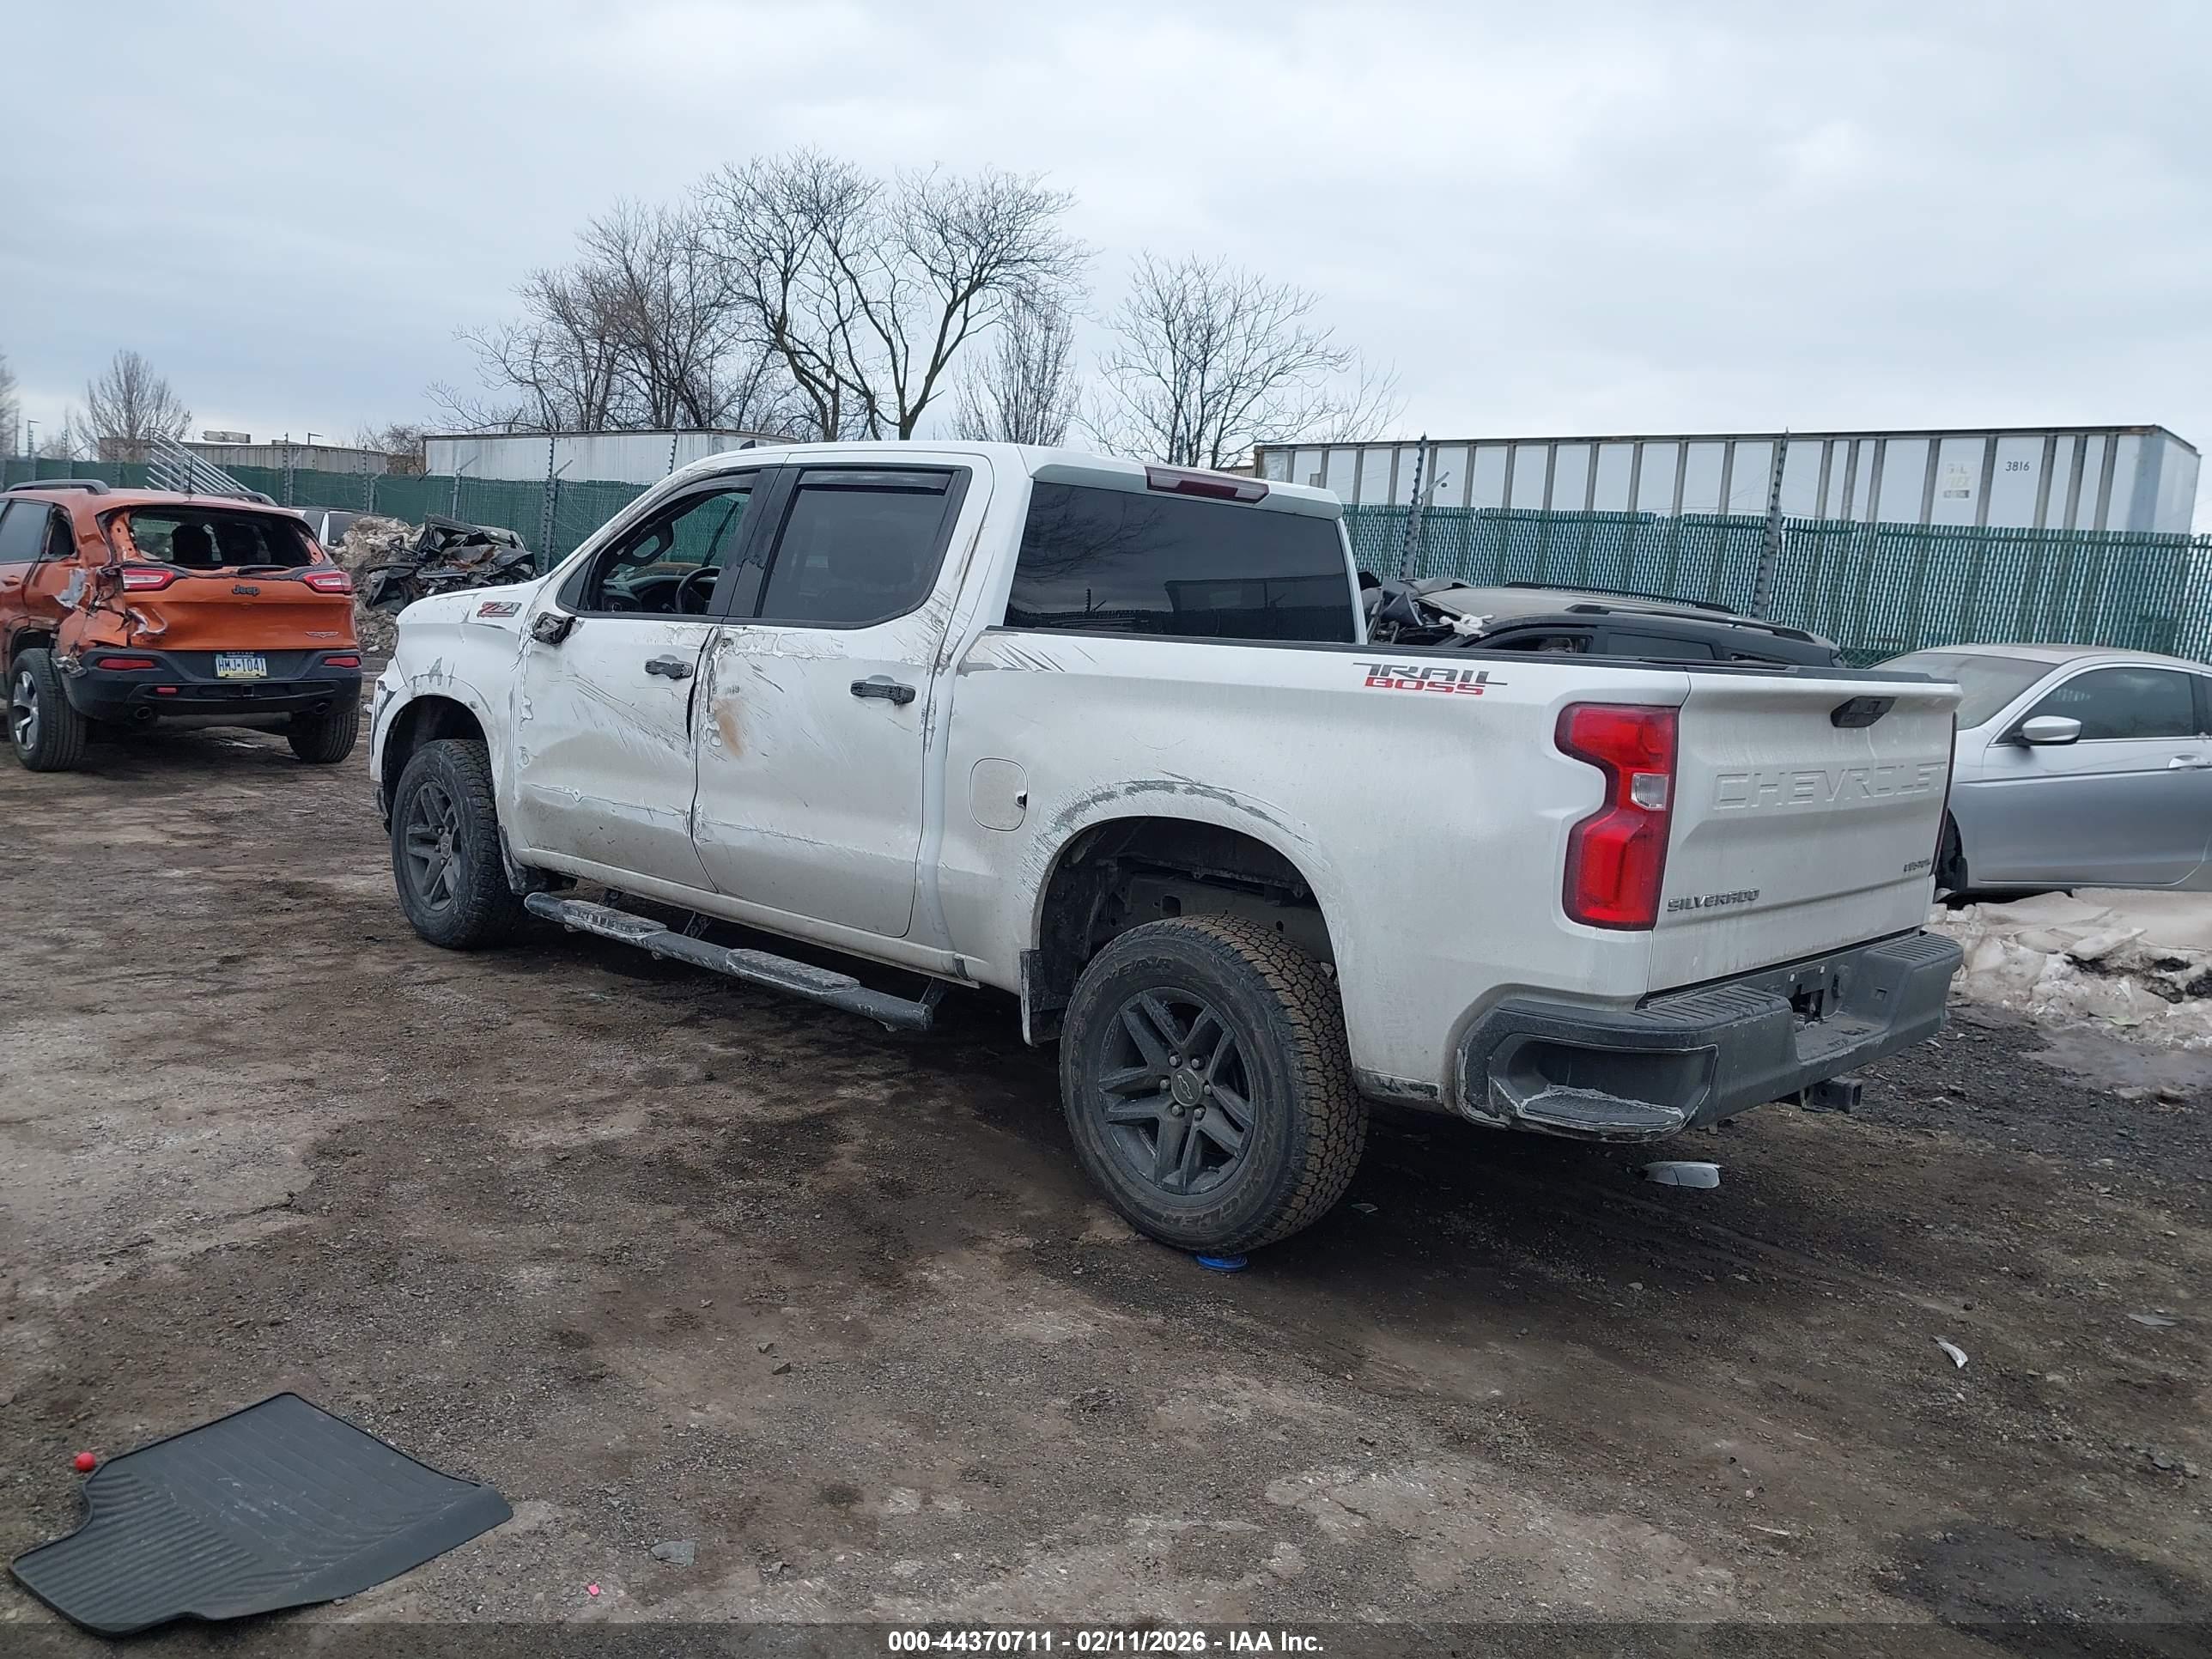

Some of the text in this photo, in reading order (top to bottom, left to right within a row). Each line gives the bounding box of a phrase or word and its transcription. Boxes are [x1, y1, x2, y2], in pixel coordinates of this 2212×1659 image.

[2004, 460, 2031, 472] 3816
[231, 584, 260, 597] Jeep
[1352, 662, 1509, 686] TRAIL
[1364, 677, 1486, 696] BOSS
[1713, 761, 1947, 810] CHEVROLET
[1667, 889, 1760, 912] SILVERADO
